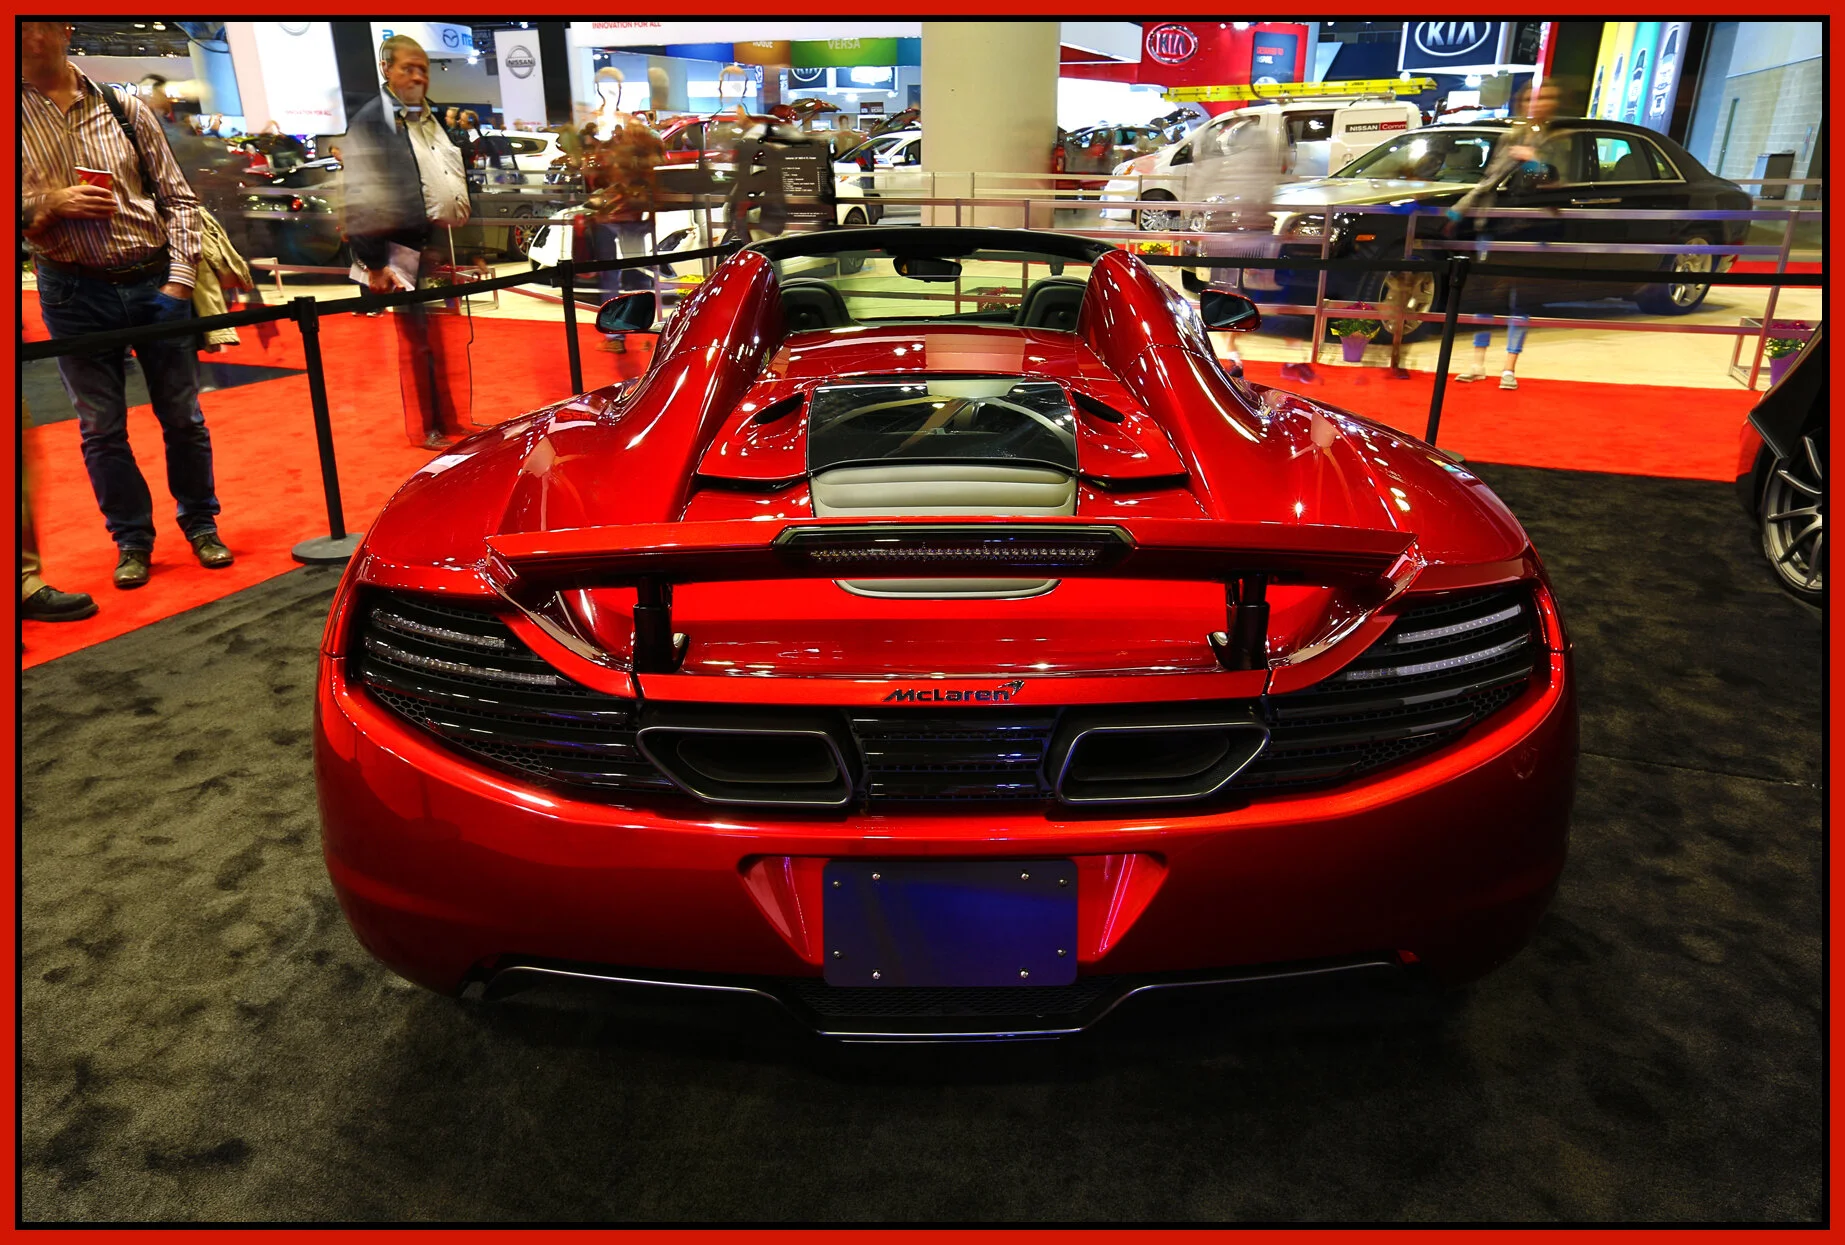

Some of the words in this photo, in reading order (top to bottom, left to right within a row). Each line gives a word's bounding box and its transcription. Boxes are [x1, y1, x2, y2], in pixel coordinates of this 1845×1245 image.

[1426, 22, 1476, 47] KIA
[827, 38, 860, 49] VERSA
[1156, 31, 1187, 55] KIA
[1350, 124, 1378, 132] NISSAN
[882, 688, 1010, 702] McLaren
